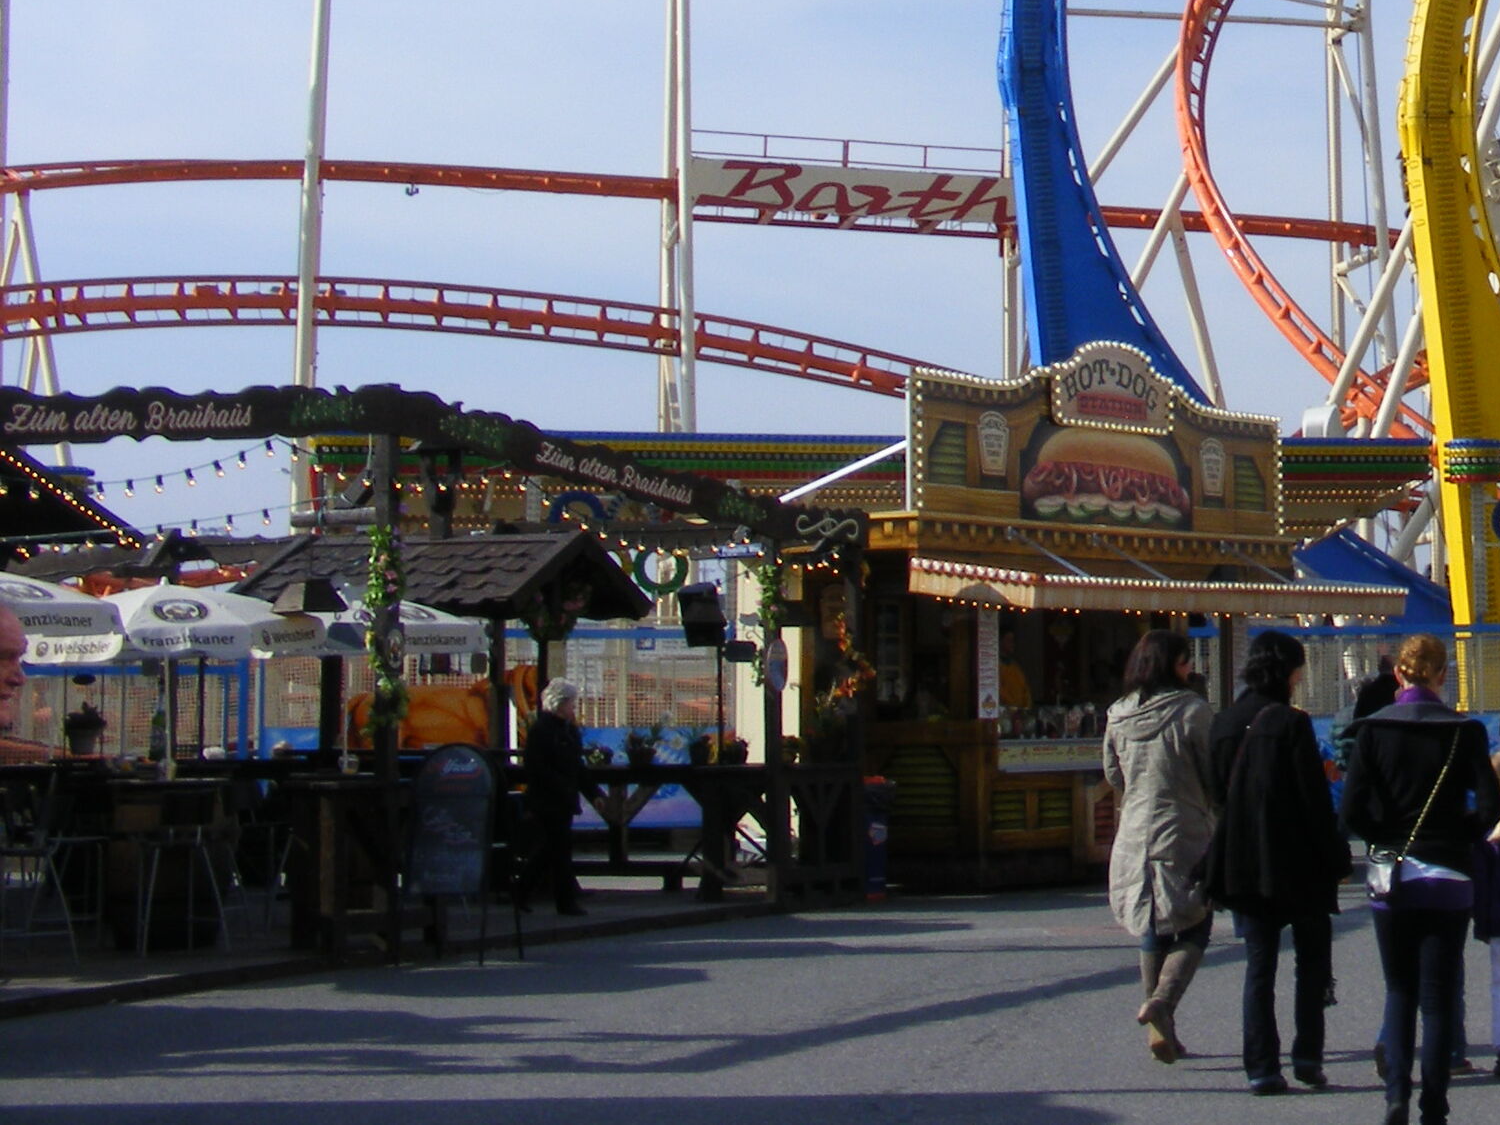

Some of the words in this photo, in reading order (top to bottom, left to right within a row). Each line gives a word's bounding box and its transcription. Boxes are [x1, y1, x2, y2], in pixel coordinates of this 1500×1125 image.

[693, 159, 1016, 226] Barth
[73, 403, 138, 432] alten
[18, 613, 93, 627] ranziskaner
[141, 634, 235, 648] Franziskaner
